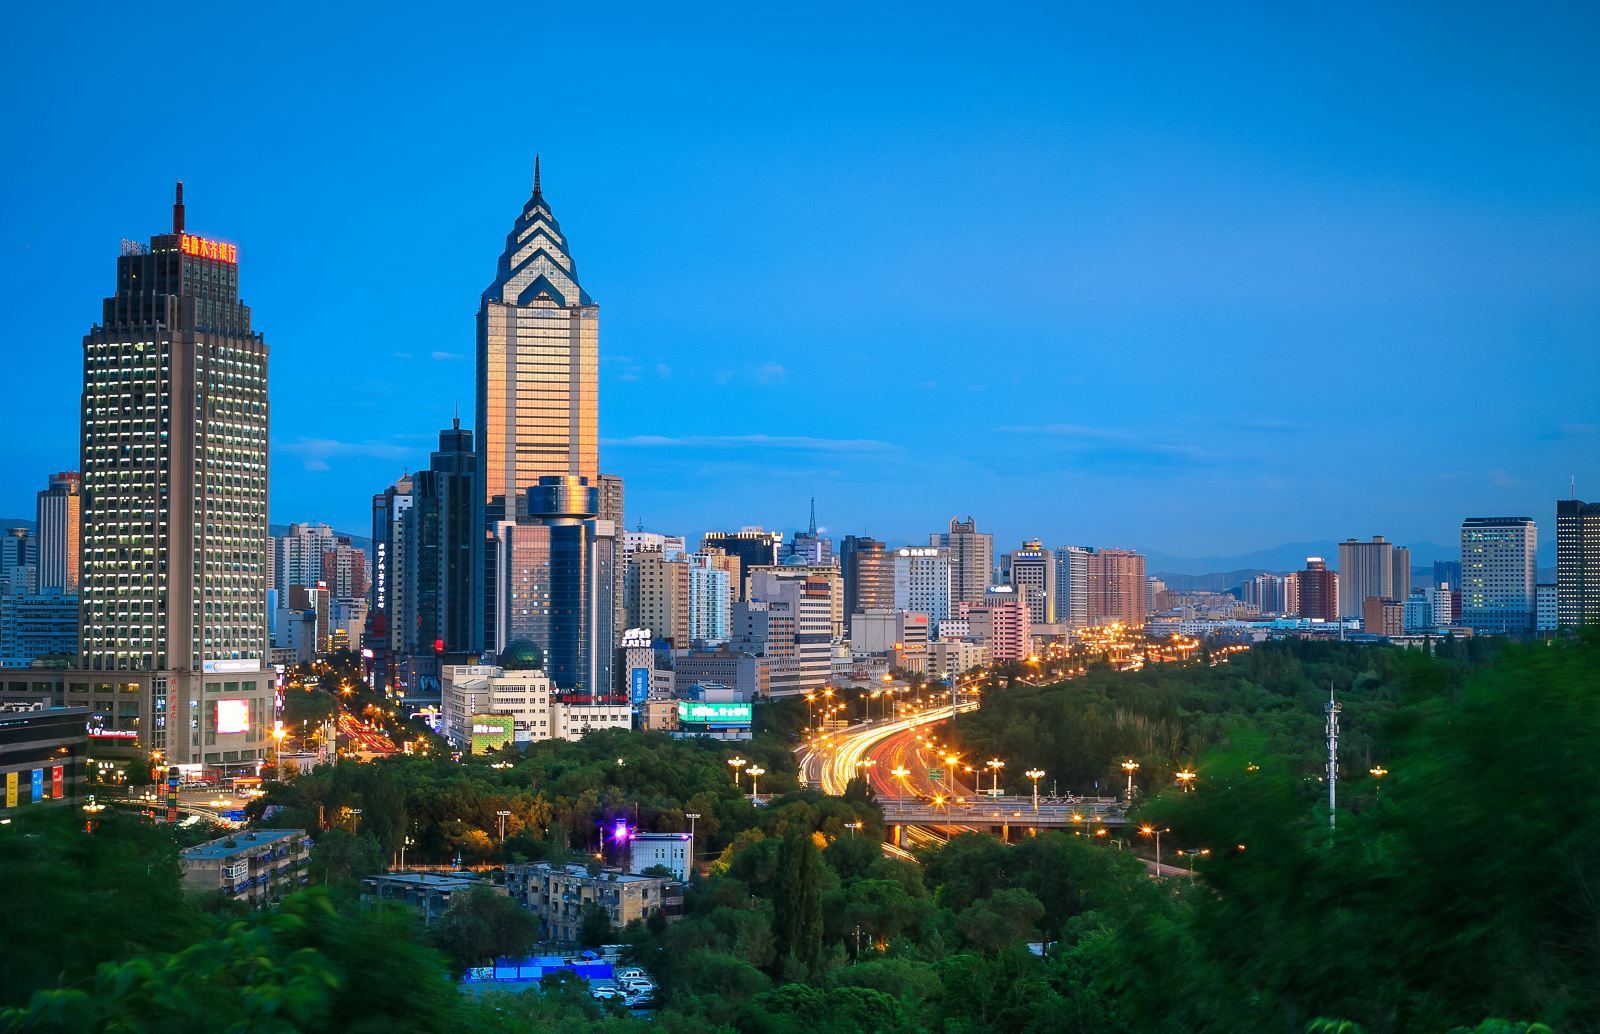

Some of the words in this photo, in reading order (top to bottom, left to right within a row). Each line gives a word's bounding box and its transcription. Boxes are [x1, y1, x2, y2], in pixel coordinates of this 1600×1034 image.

[181, 234, 237, 264] 乌鲁木齐银行
